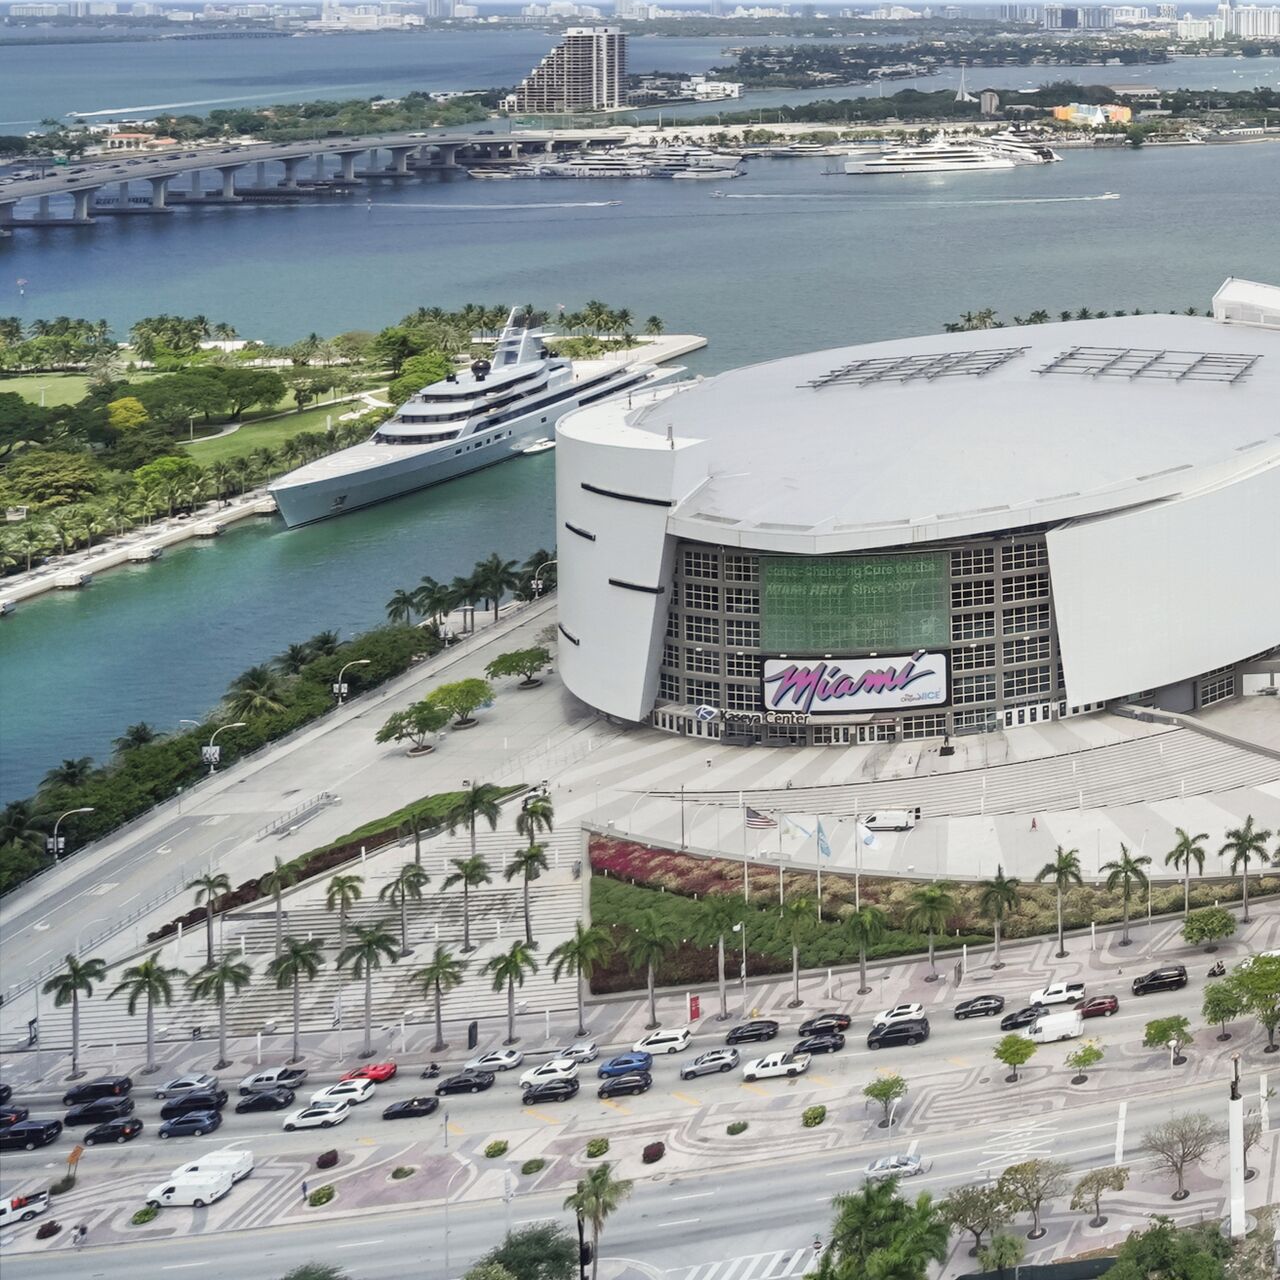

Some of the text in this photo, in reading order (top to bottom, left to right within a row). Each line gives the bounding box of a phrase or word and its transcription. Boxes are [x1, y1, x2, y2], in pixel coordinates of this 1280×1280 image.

[763, 651, 936, 714] Miami
[720, 708, 811, 726] Kaseya Center
